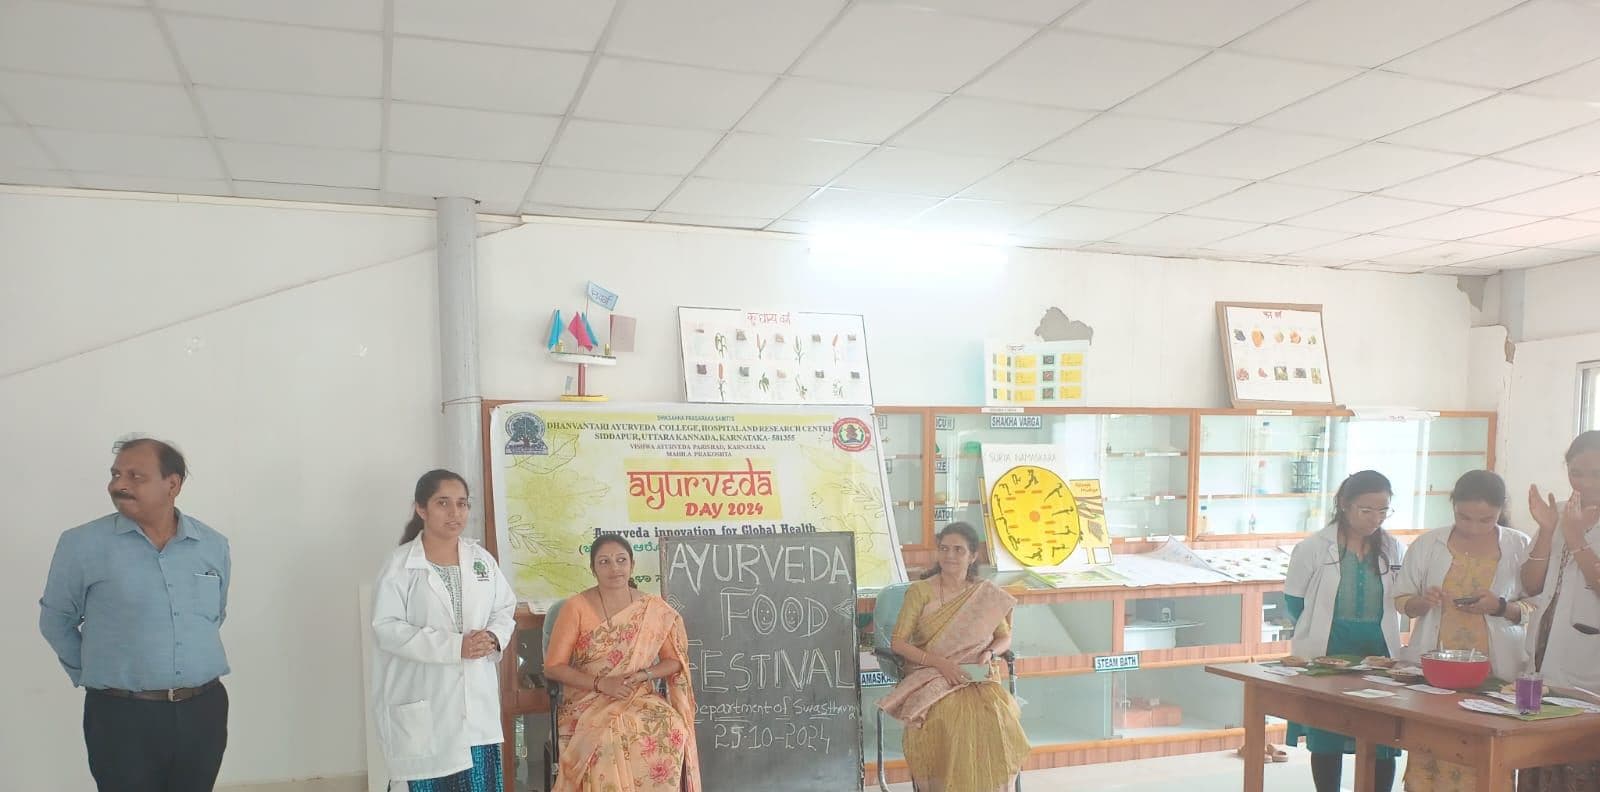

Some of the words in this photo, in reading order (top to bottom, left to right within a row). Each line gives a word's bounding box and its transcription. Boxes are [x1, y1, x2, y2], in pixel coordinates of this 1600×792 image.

[546, 421, 610, 432] DHANVANTARI
[611, 423, 657, 432] AYURVEDA
[659, 423, 701, 433] COLLEGE,
[759, 424, 801, 433] RESEARCH
[802, 424, 833, 433] CENTRE
[991, 416, 1017, 427] SHAKHA
[1019, 416, 1040, 427] VARGA
[594, 432, 640, 442] SIDDAPUR,
[641, 433, 675, 442] UTTARA
[676, 433, 718, 442] KANNADA,
[666, 450, 692, 458] MAHILA
[627, 458, 773, 510] ayurveda
[685, 502, 724, 519] DAY
[728, 502, 764, 516] 2024
[655, 526, 716, 537] innovation
[722, 525, 737, 535] for
[741, 523, 777, 535] Global
[782, 522, 817, 534] Health
[669, 543, 852, 596] AYURVEDA
[720, 586, 829, 640] FOOD
[1096, 658, 1119, 669] STEAM
[1119, 656, 1137, 667] BATH
[774, 695, 791, 715] of
